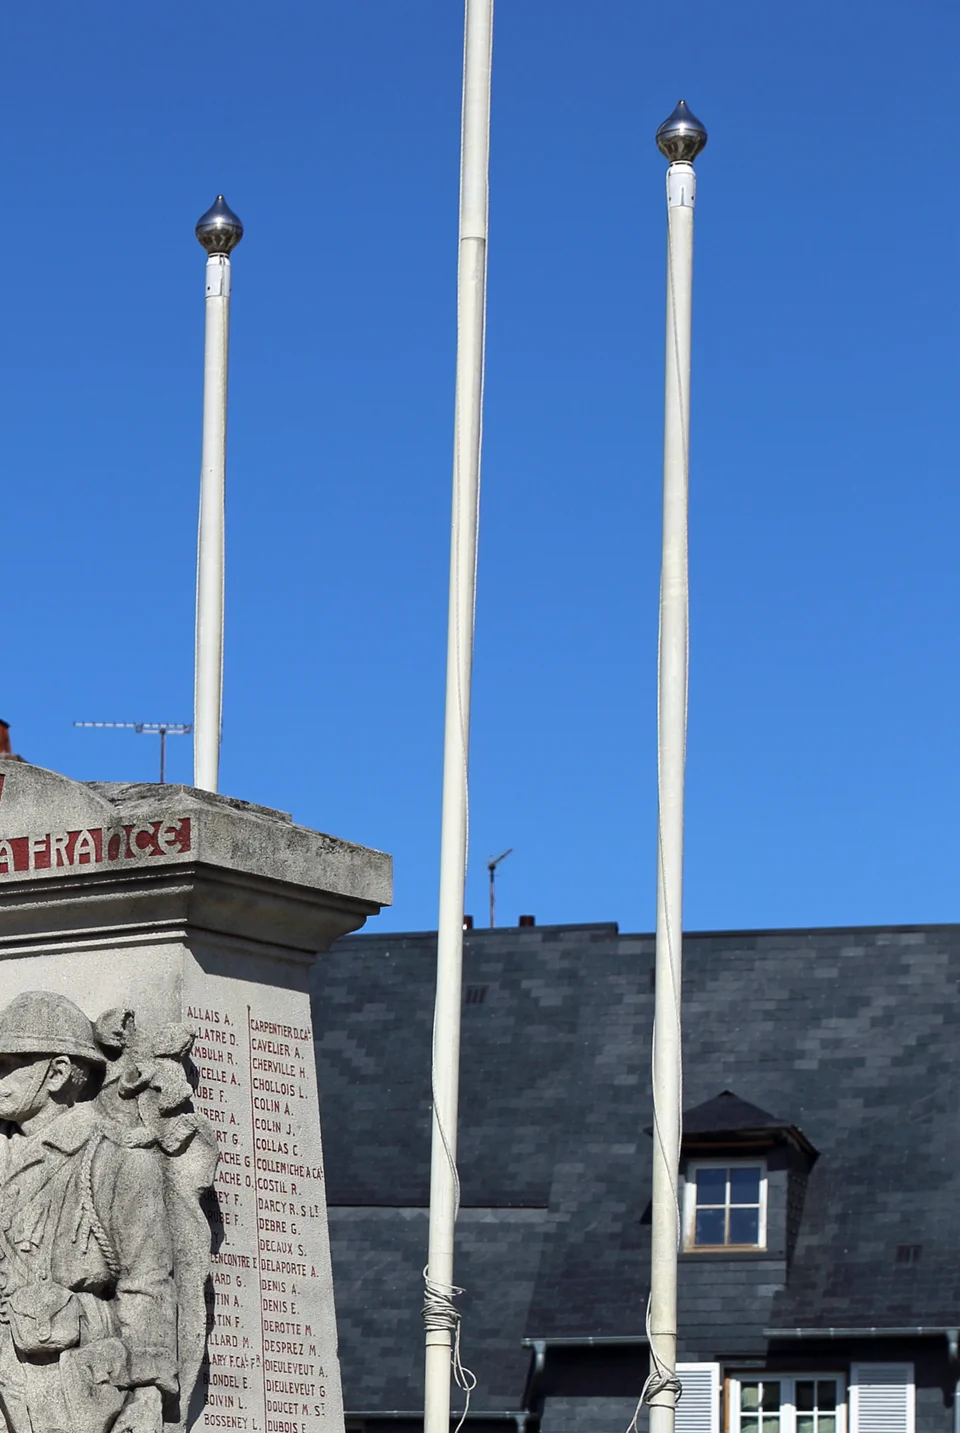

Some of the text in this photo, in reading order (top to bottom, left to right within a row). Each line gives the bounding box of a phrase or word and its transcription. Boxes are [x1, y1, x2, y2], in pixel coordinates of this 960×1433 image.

[29, 818, 185, 869] FRANCE
[187, 1006, 233, 1026] ALLAIS A.
[194, 1027, 226, 1044] LLATRE
[251, 1019, 292, 1038] CARPENTIER
[252, 1038, 290, 1056] CAVELIER
[228, 1052, 238, 1064] R.
[253, 1058, 295, 1076] CHERVILLE
[231, 1073, 240, 1086] A.
[253, 1078, 295, 1096] CHOLLOIS
[219, 1090, 227, 1102] F.
[255, 1097, 280, 1112] COLIN
[230, 1113, 239, 1125] A.
[255, 1118, 281, 1133] COLIN
[256, 1138, 288, 1154] COLLAS
[256, 1158, 304, 1177] COLLEMICHE
[257, 1178, 287, 1194] COSTIL
[234, 1194, 242, 1206] F.
[258, 1198, 286, 1214] DARCY
[259, 1218, 286, 1232] DEBRE
[260, 1239, 292, 1255] DECAUX
[261, 1259, 306, 1276] DELAPORTE
[262, 1280, 286, 1292] DENIS
[205, 1292, 243, 1307] ERTIN A.
[263, 1298, 288, 1313] DENIS
[206, 1313, 243, 1328] ERTIN F.
[264, 1320, 301, 1335] DEROTTE
[265, 1340, 304, 1355] DESPREZ
[265, 1360, 314, 1376] DIEULEVEUT
[204, 1372, 251, 1389] BLONDEL E.
[266, 1380, 315, 1396] DIEULEVEUT
[205, 1394, 234, 1408] BOIVIN
[267, 1400, 298, 1415] DOUCET
[204, 1414, 248, 1429] BOSSENEY
[268, 1420, 298, 1433] DUBOIS
